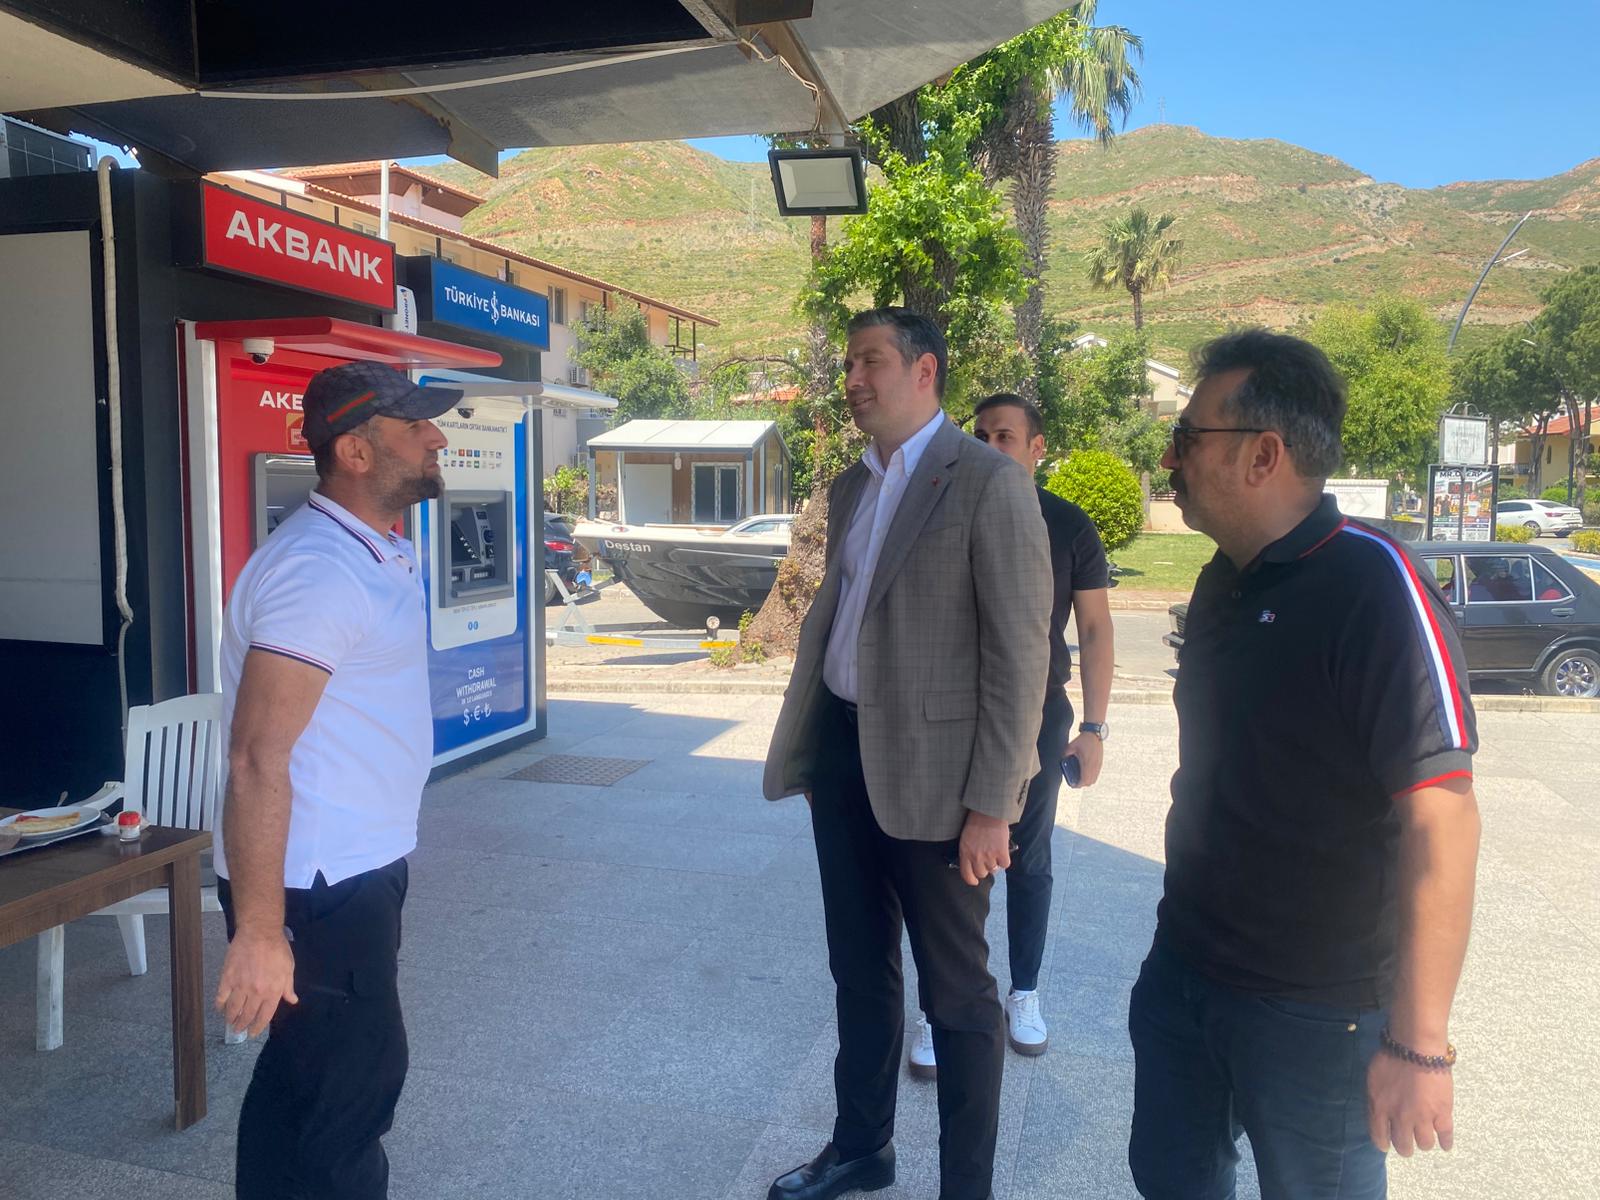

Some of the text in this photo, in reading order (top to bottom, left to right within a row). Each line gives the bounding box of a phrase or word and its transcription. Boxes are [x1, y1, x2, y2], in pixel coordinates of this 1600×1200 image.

[226, 210, 383, 285] AKBANK
[444, 285, 490, 313] TÜRKİYE
[500, 304, 540, 327] BANKASI
[605, 539, 651, 552] Destan
[468, 666, 485, 680] CASH
[456, 677, 497, 698] WITHDRAWAL
